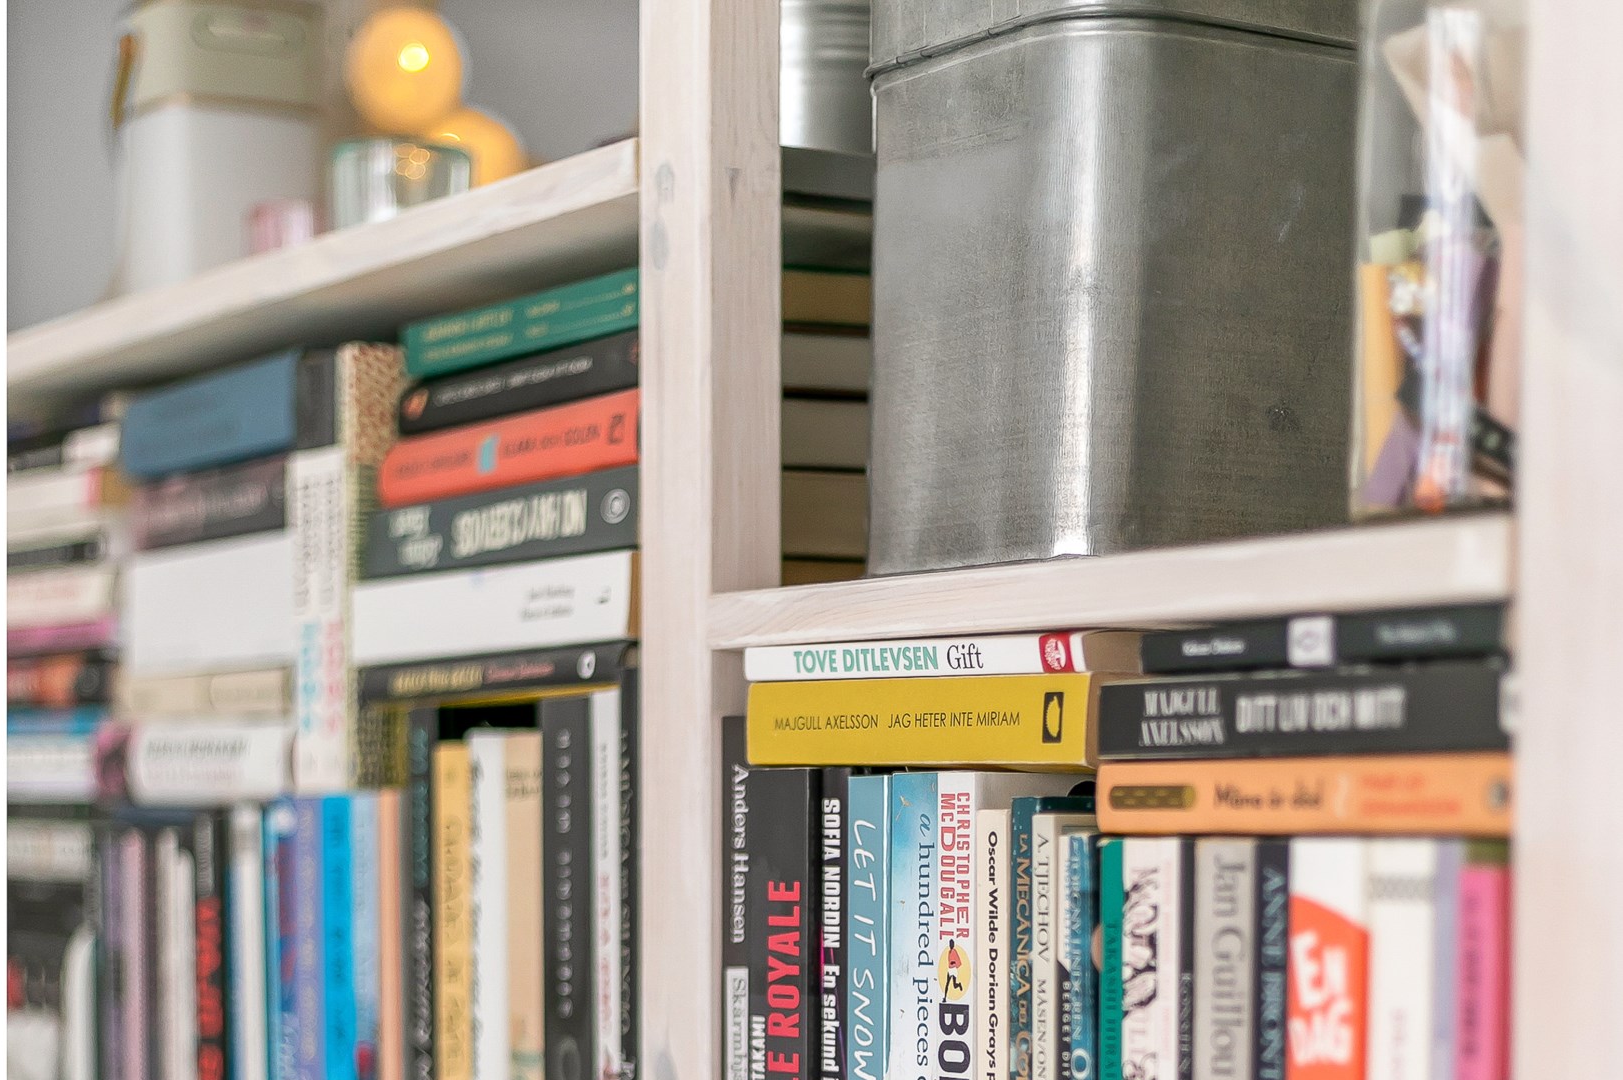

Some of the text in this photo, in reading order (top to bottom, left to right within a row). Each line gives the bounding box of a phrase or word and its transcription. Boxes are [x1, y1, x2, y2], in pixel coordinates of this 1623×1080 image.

[793, 642, 984, 674] TOVE DITLEVSEN Gift
[774, 710, 1021, 732] MAJGULL AXELSSON JAG HETER INTE MIRIAM
[732, 763, 750, 944] Anders Hansen
[822, 798, 841, 861] SOFIA
[919, 813, 932, 837] a
[1019, 834, 1027, 853] LA
[1037, 833, 1049, 854] A.
[853, 819, 877, 902] LET
[956, 792, 972, 940] CHRISTOPHER
[987, 831, 998, 885] Oscar
[822, 866, 841, 949] NORDIN
[853, 914, 877, 957] IT
[917, 842, 935, 968] hundred
[988, 887, 999, 943] Wilde
[1035, 856, 1049, 963] TJECHOV
[1261, 866, 1286, 967] ANNE
[766, 881, 801, 1038] ROYALE
[823, 964, 841, 989] En
[988, 948, 999, 1011] Dorian
[1209, 853, 1245, 1077] Jan Guillou
[821, 992, 841, 1073] sekund
[912, 976, 933, 1067] pieces
[986, 1014, 998, 1068] Grays
[1061, 980, 1072, 1047] BERGET
[1061, 1051, 1071, 1077] DIT
